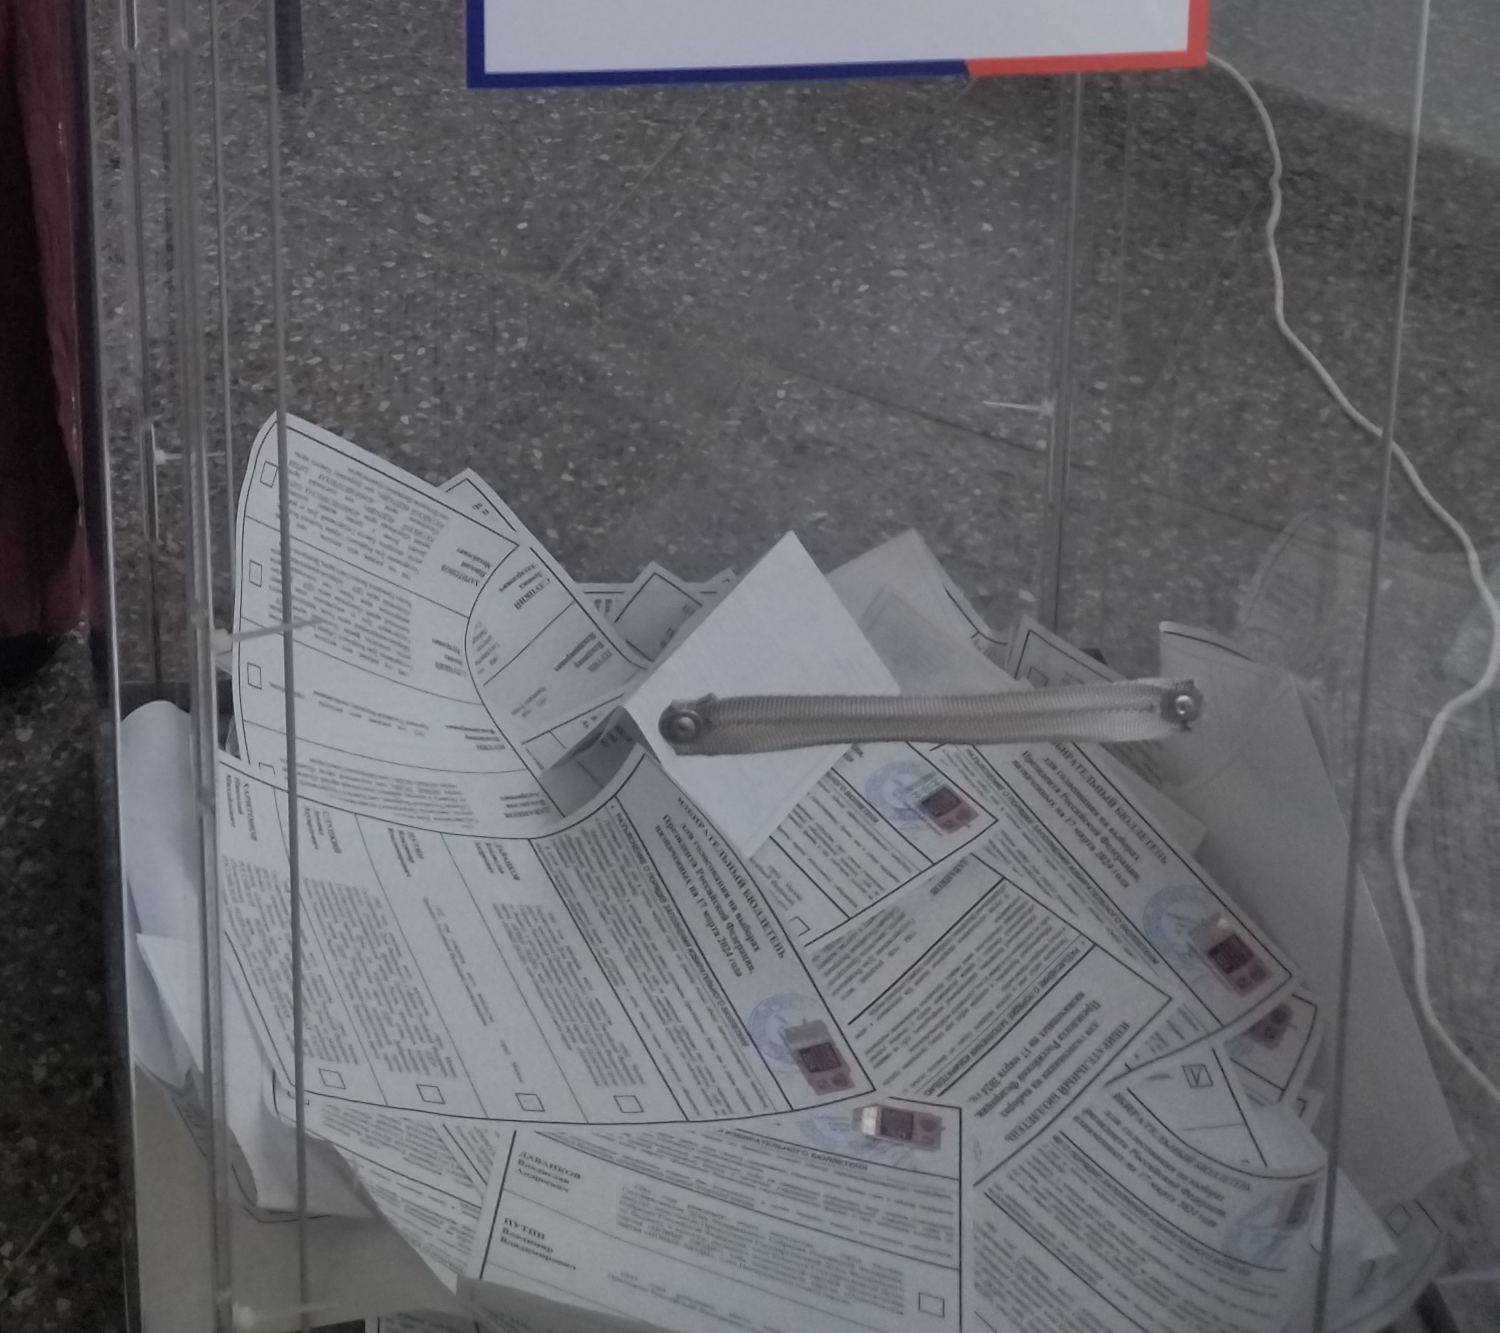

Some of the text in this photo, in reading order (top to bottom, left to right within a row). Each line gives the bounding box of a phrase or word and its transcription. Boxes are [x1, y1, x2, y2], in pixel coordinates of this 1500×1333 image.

[513, 577, 549, 610] СЛУЦКИЙ
[1050, 736, 1169, 865] ЗБИРАТЕЛЬНЫЙ БЮЛЛЕТЕНЬ
[1094, 849, 1114, 871] 2024
[693, 867, 729, 921] Российской
[694, 896, 707, 909] 17
[716, 935, 734, 957] 2024
[741, 887, 788, 959] БЮЛЛЕТЕНЬ
[1019, 1046, 1032, 1059] 17
[1003, 1019, 1131, 1144] ИЗБИРАТЕЛЬНЫЙ БЮЛЛЕТЕНЬ
[1072, 1114, 1125, 1161] азначенных
[1082, 1106, 1129, 1150] резидента
[518, 1150, 581, 1179] ДАВАНКОВ
[503, 1217, 545, 1239] ПУТИН
